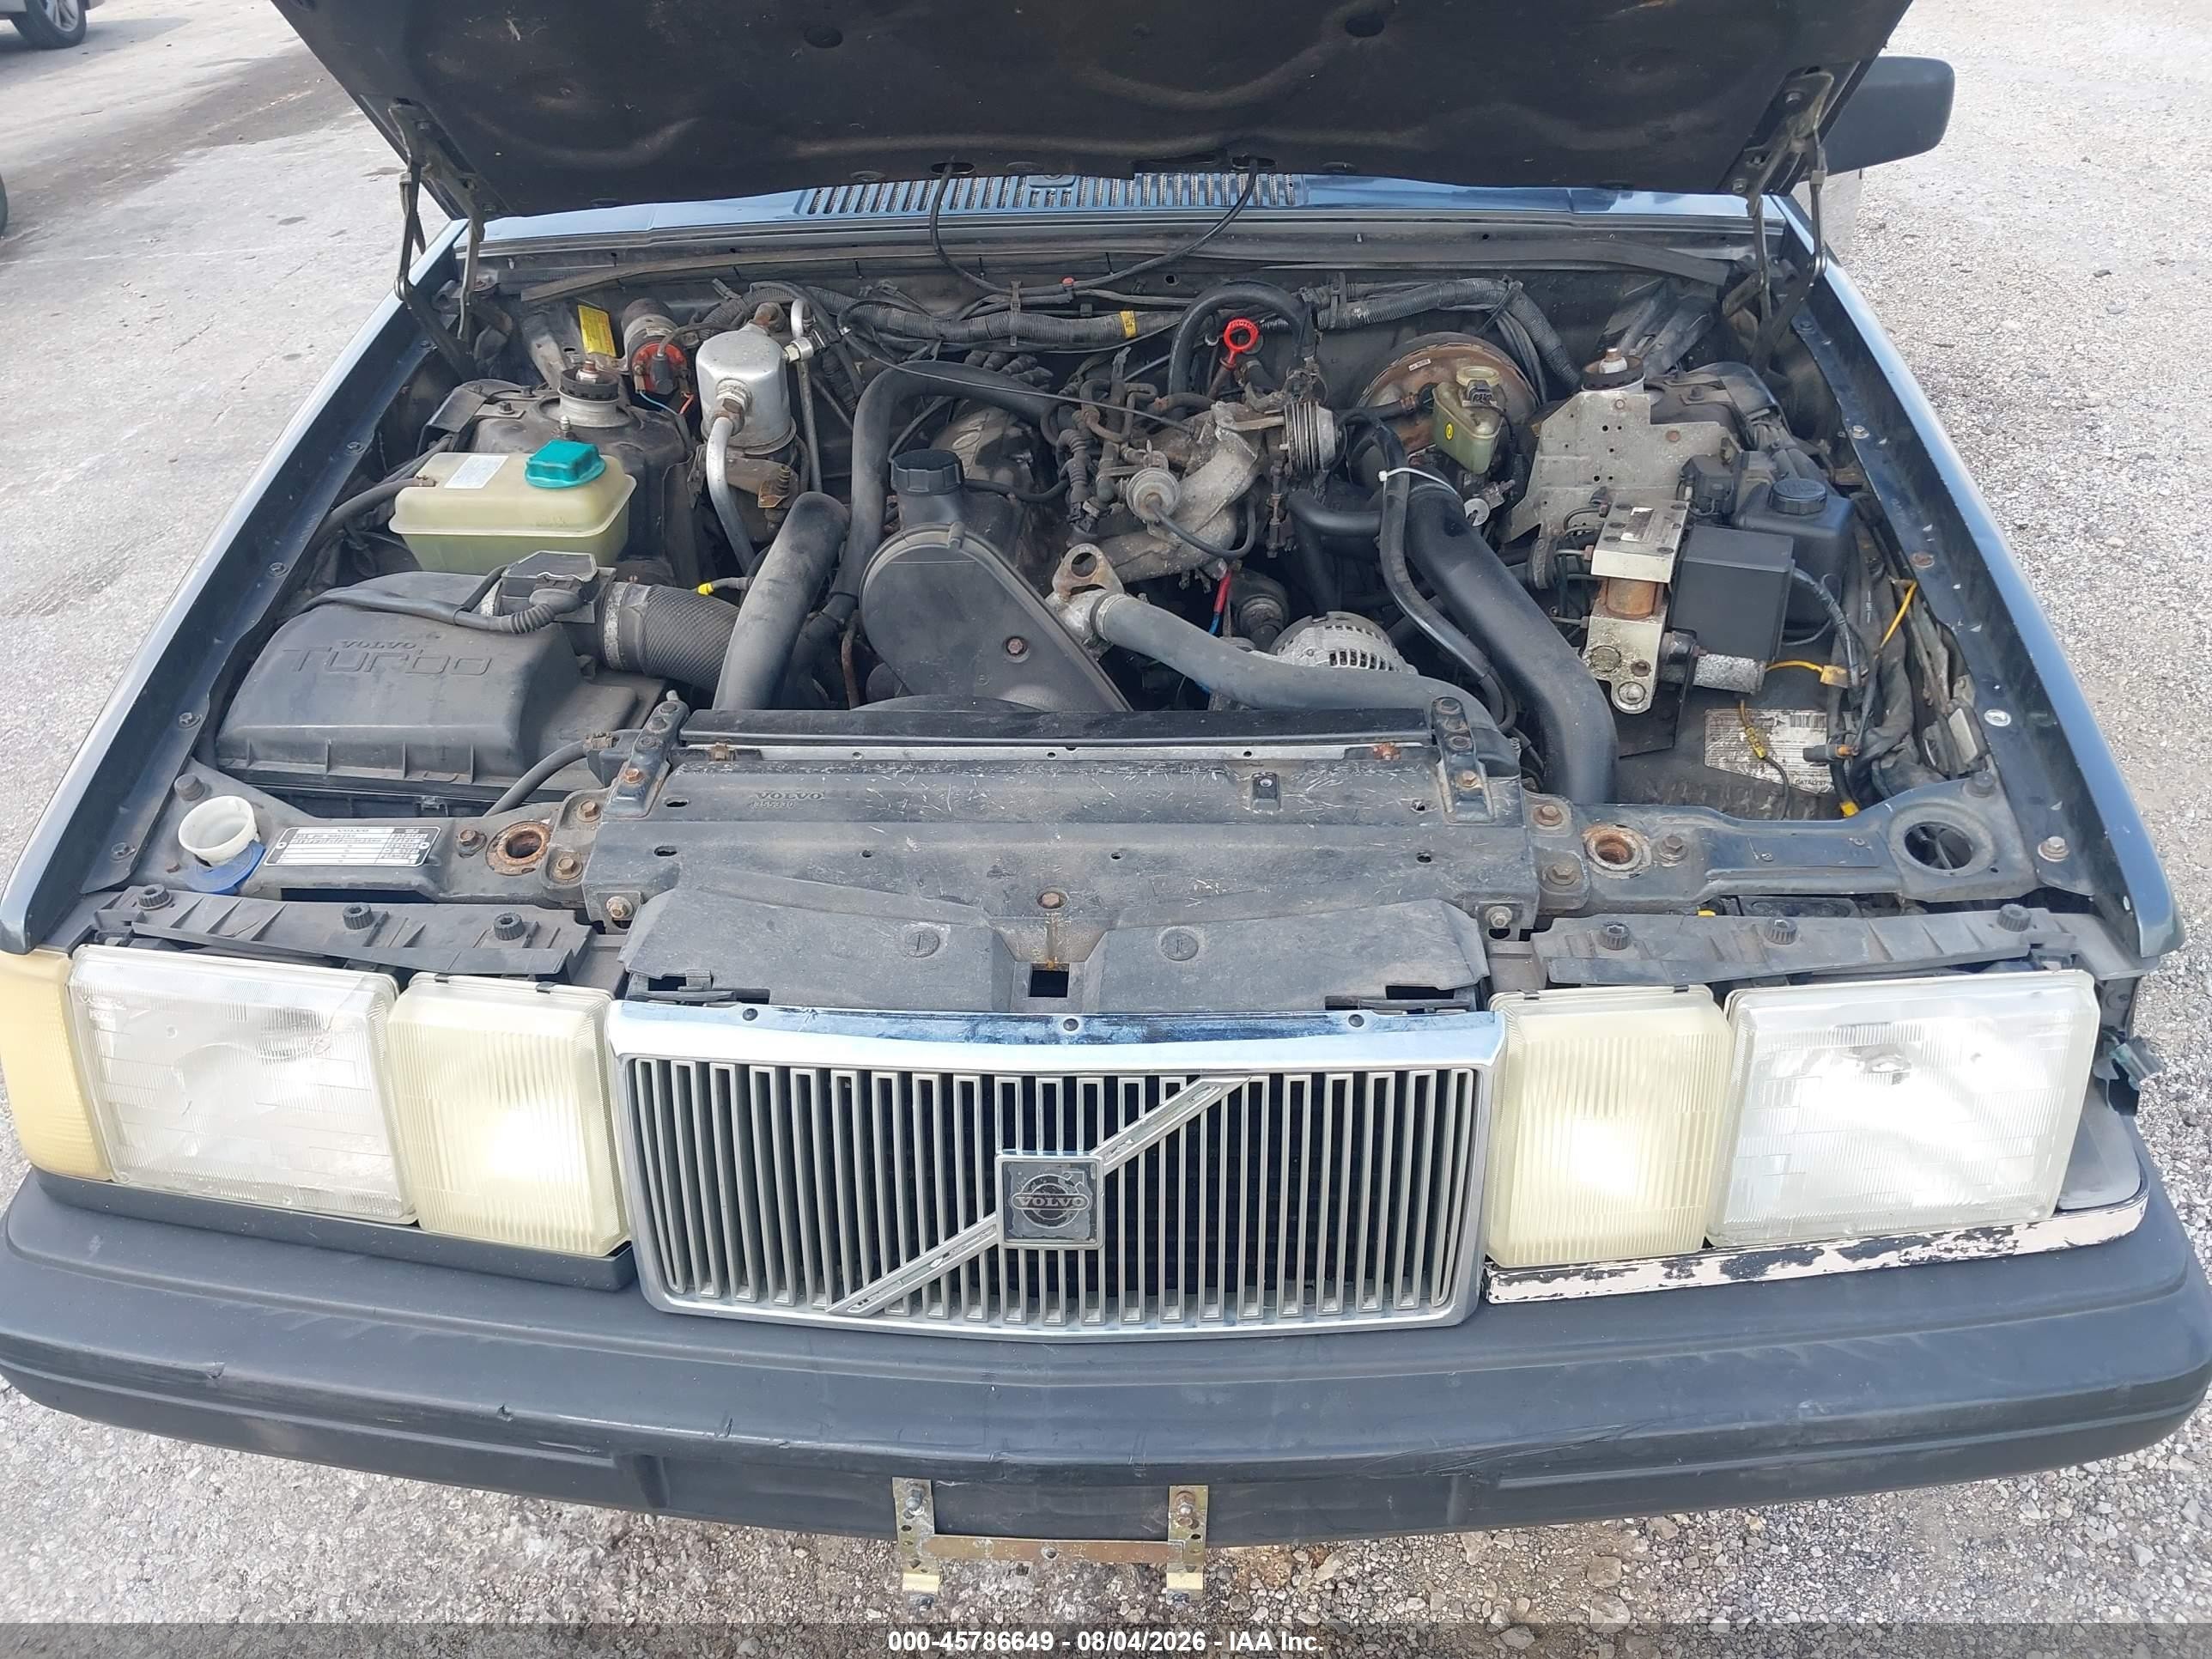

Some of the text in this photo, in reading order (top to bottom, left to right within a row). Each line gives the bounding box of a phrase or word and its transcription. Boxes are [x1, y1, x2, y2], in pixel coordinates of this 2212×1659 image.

[340, 641, 416, 650] VOLVO
[755, 791, 823, 799] VOLVO
[1015, 1196, 1085, 1207] VOLVO
